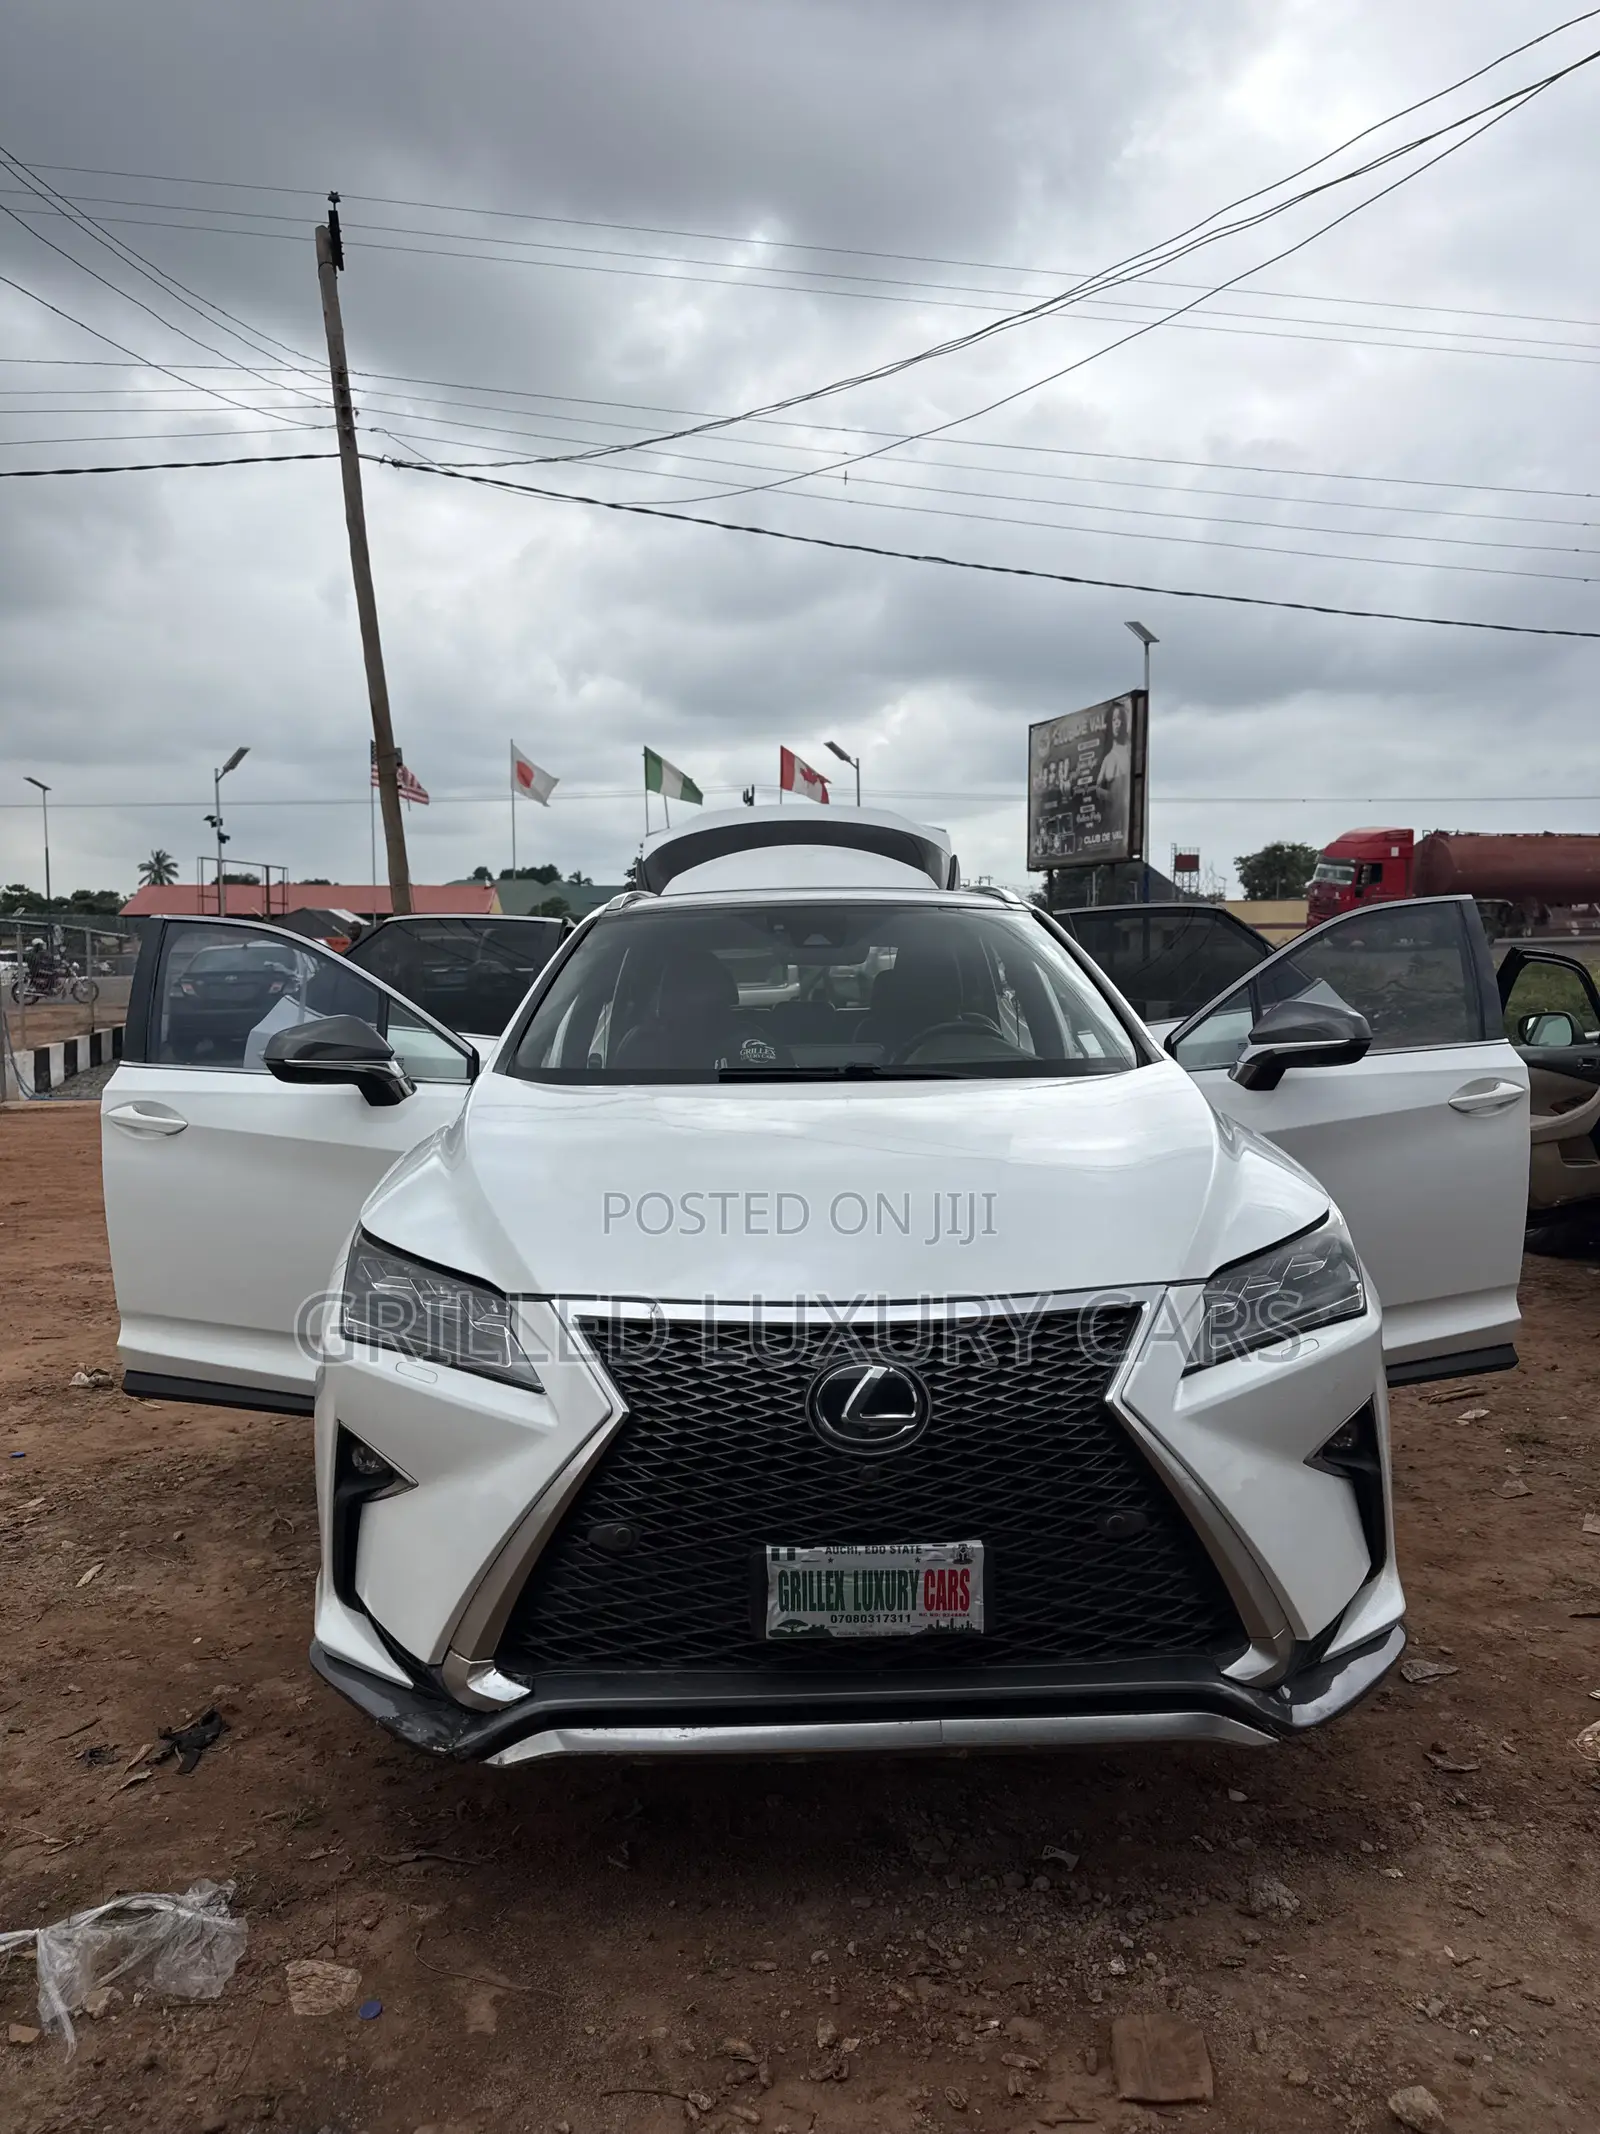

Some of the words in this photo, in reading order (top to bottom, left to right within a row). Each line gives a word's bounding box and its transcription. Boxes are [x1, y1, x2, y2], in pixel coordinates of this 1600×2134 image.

[740, 1047, 776, 1056] GRILLEX
[825, 1545, 861, 1556] AUCHI,
[865, 1545, 886, 1555] EDO
[889, 1545, 922, 1555] STATE
[778, 1569, 845, 1611] GRILLEX
[853, 1570, 919, 1611] LUXURY
[924, 1569, 970, 1611] CARS
[830, 1614, 911, 1624] 07080317311
